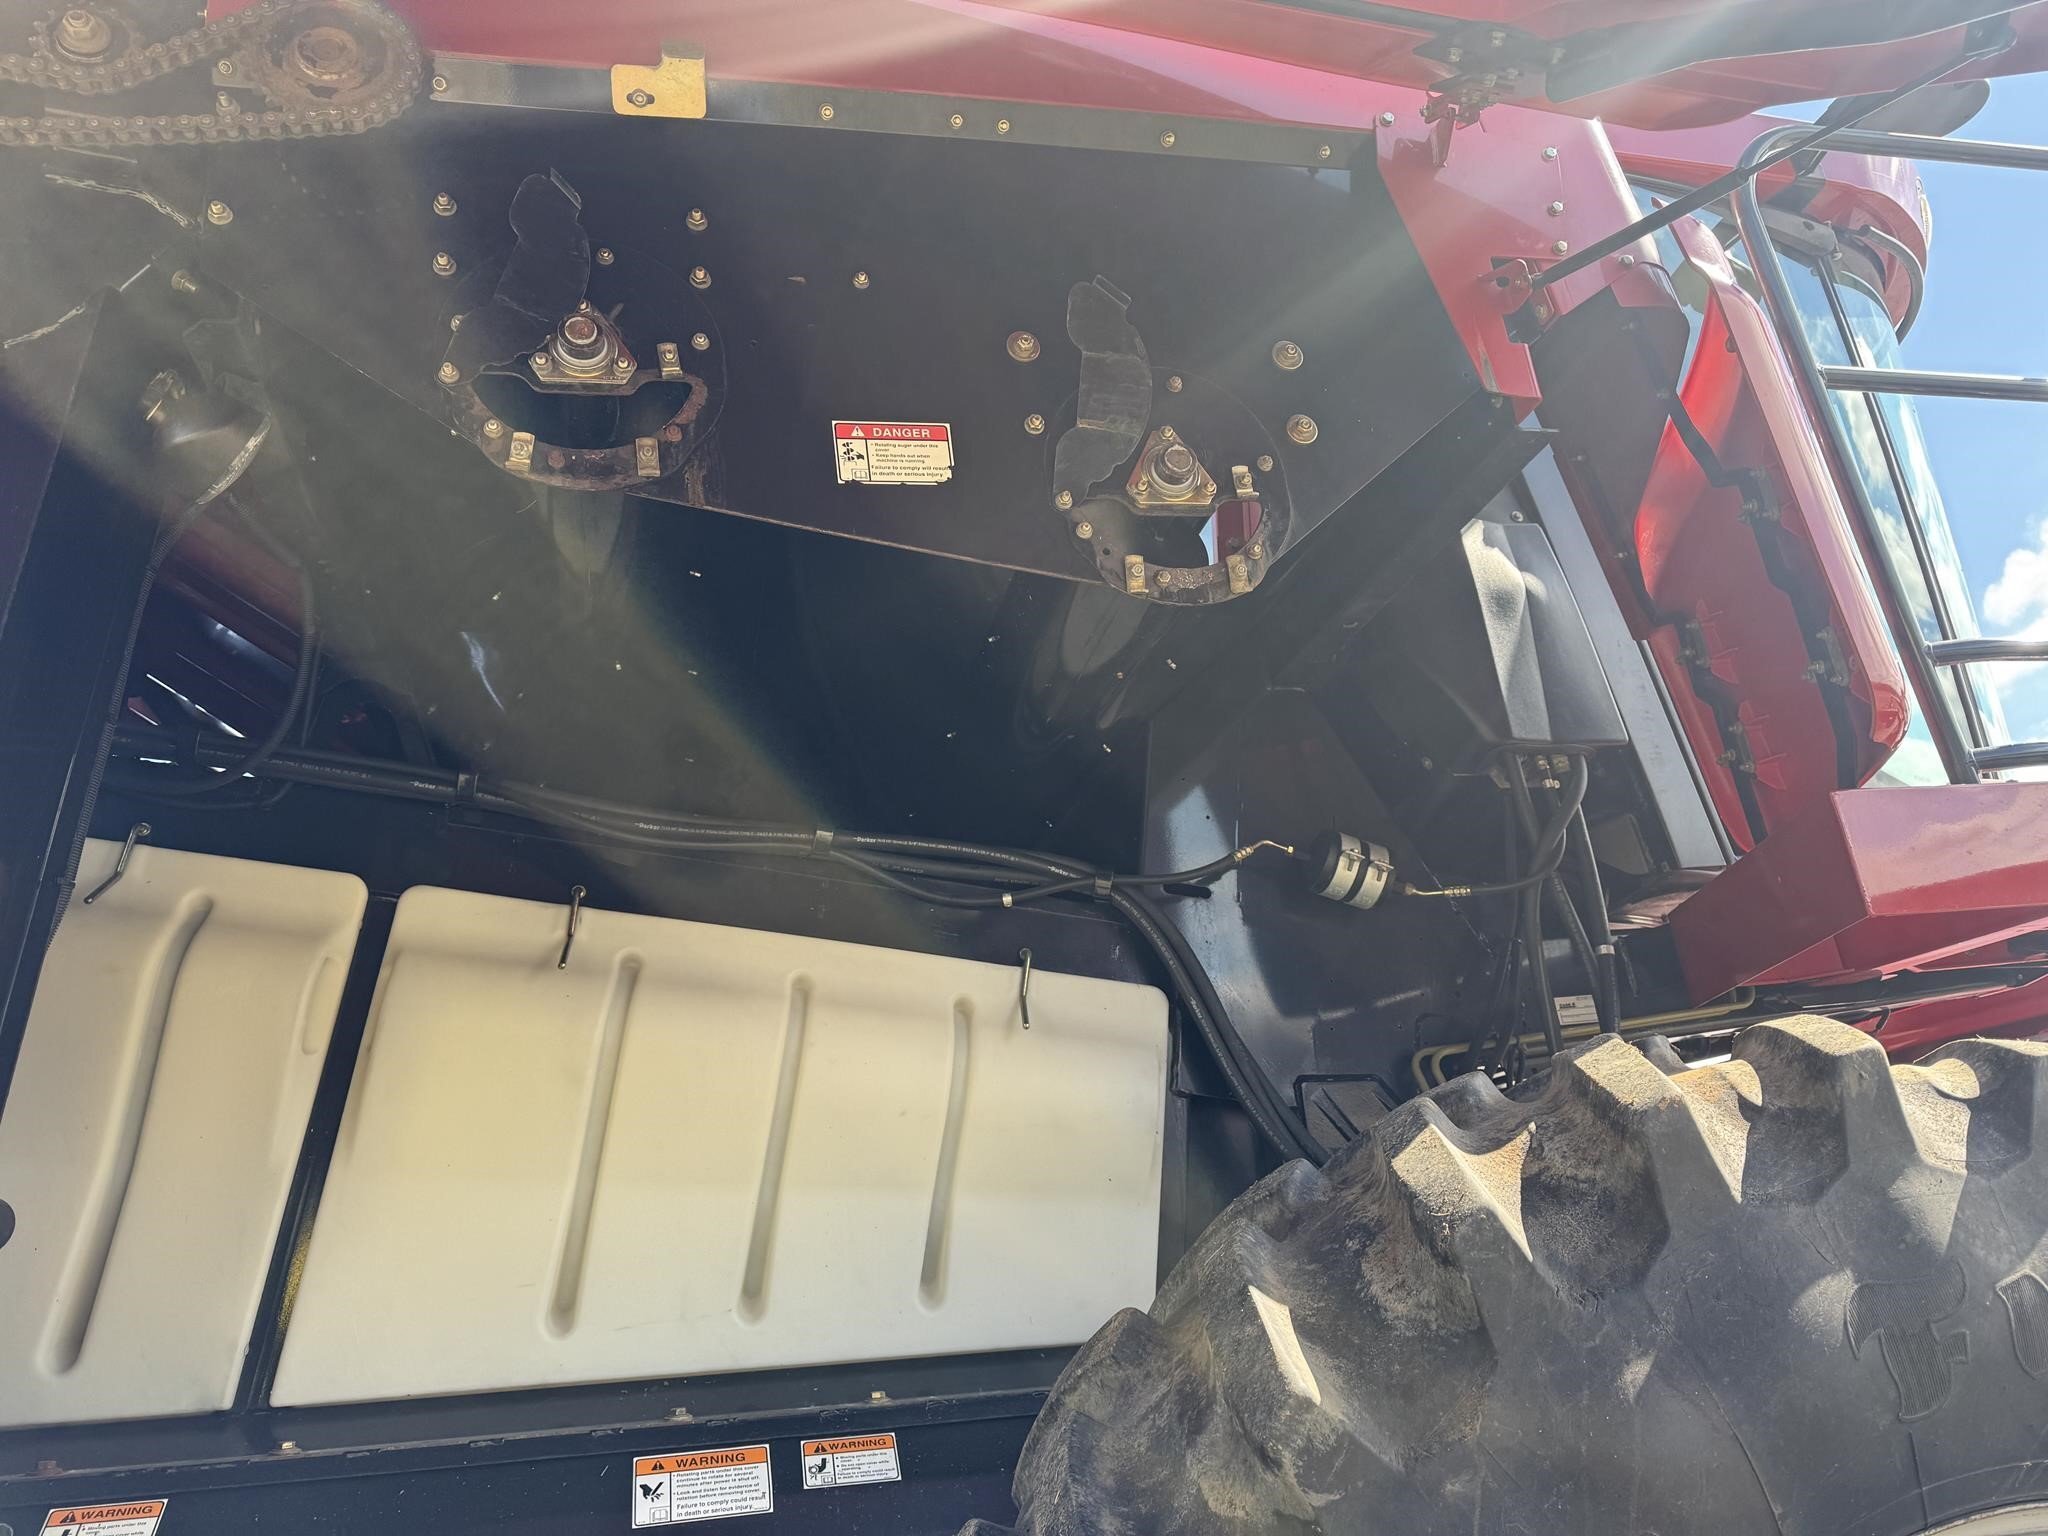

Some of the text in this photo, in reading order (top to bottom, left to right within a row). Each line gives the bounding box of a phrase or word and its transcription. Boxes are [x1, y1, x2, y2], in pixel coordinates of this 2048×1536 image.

[873, 428, 930, 437] DANGER
[829, 1439, 886, 1450] WARNING
[676, 1453, 745, 1468] WARNING
[81, 1506, 152, 1520] WARNING
